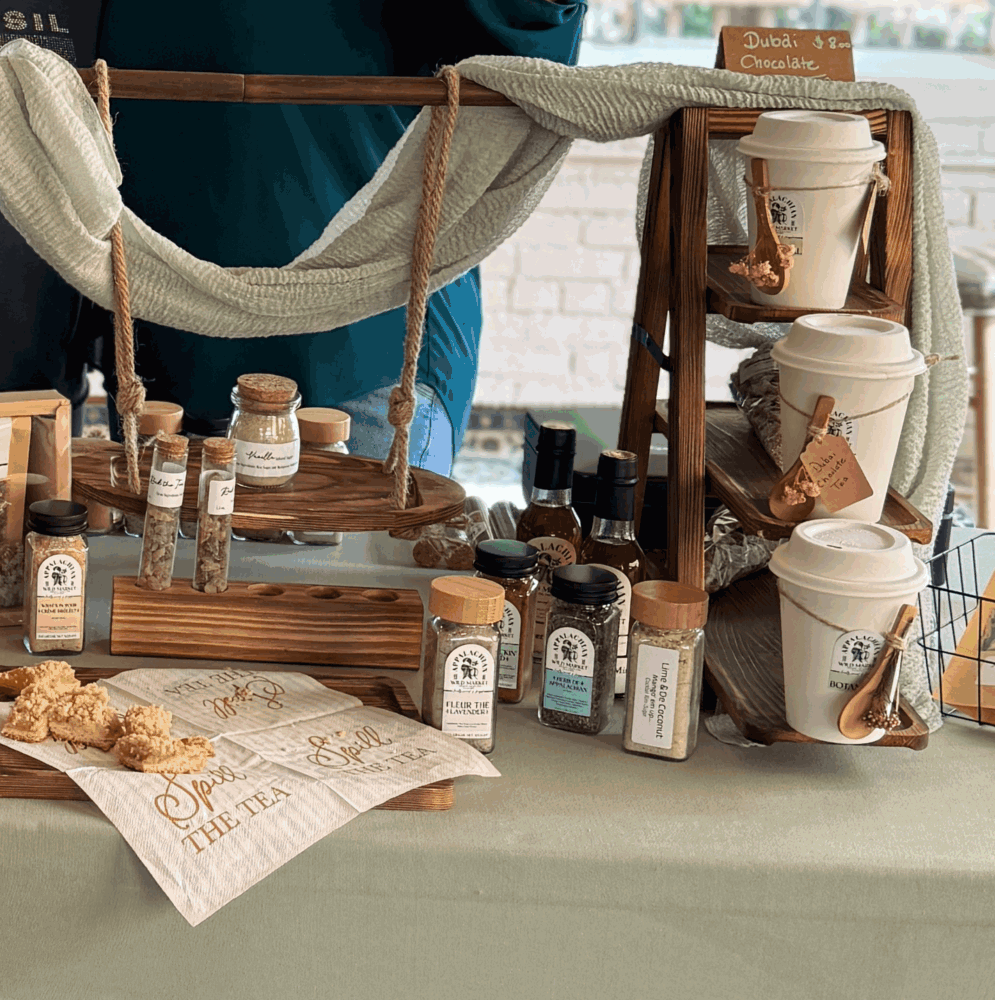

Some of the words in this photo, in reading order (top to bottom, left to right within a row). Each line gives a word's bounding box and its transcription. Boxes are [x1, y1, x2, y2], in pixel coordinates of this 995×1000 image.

[743, 30, 798, 50] Dubai
[740, 54, 820, 71] Chocolate
[809, 453, 836, 473] Dubai
[830, 477, 849, 489] Tea
[660, 662, 670, 683] Lime
[446, 701, 472, 709] FLEUR
[474, 701, 489, 709] THE
[658, 691, 668, 703] De
[656, 703, 667, 739] Coconut
[306, 725, 393, 771] Spill
[393, 745, 438, 765] TEA
[155, 764, 248, 831] Spill
[180, 811, 241, 855] THE
[235, 784, 292, 823] TEA
